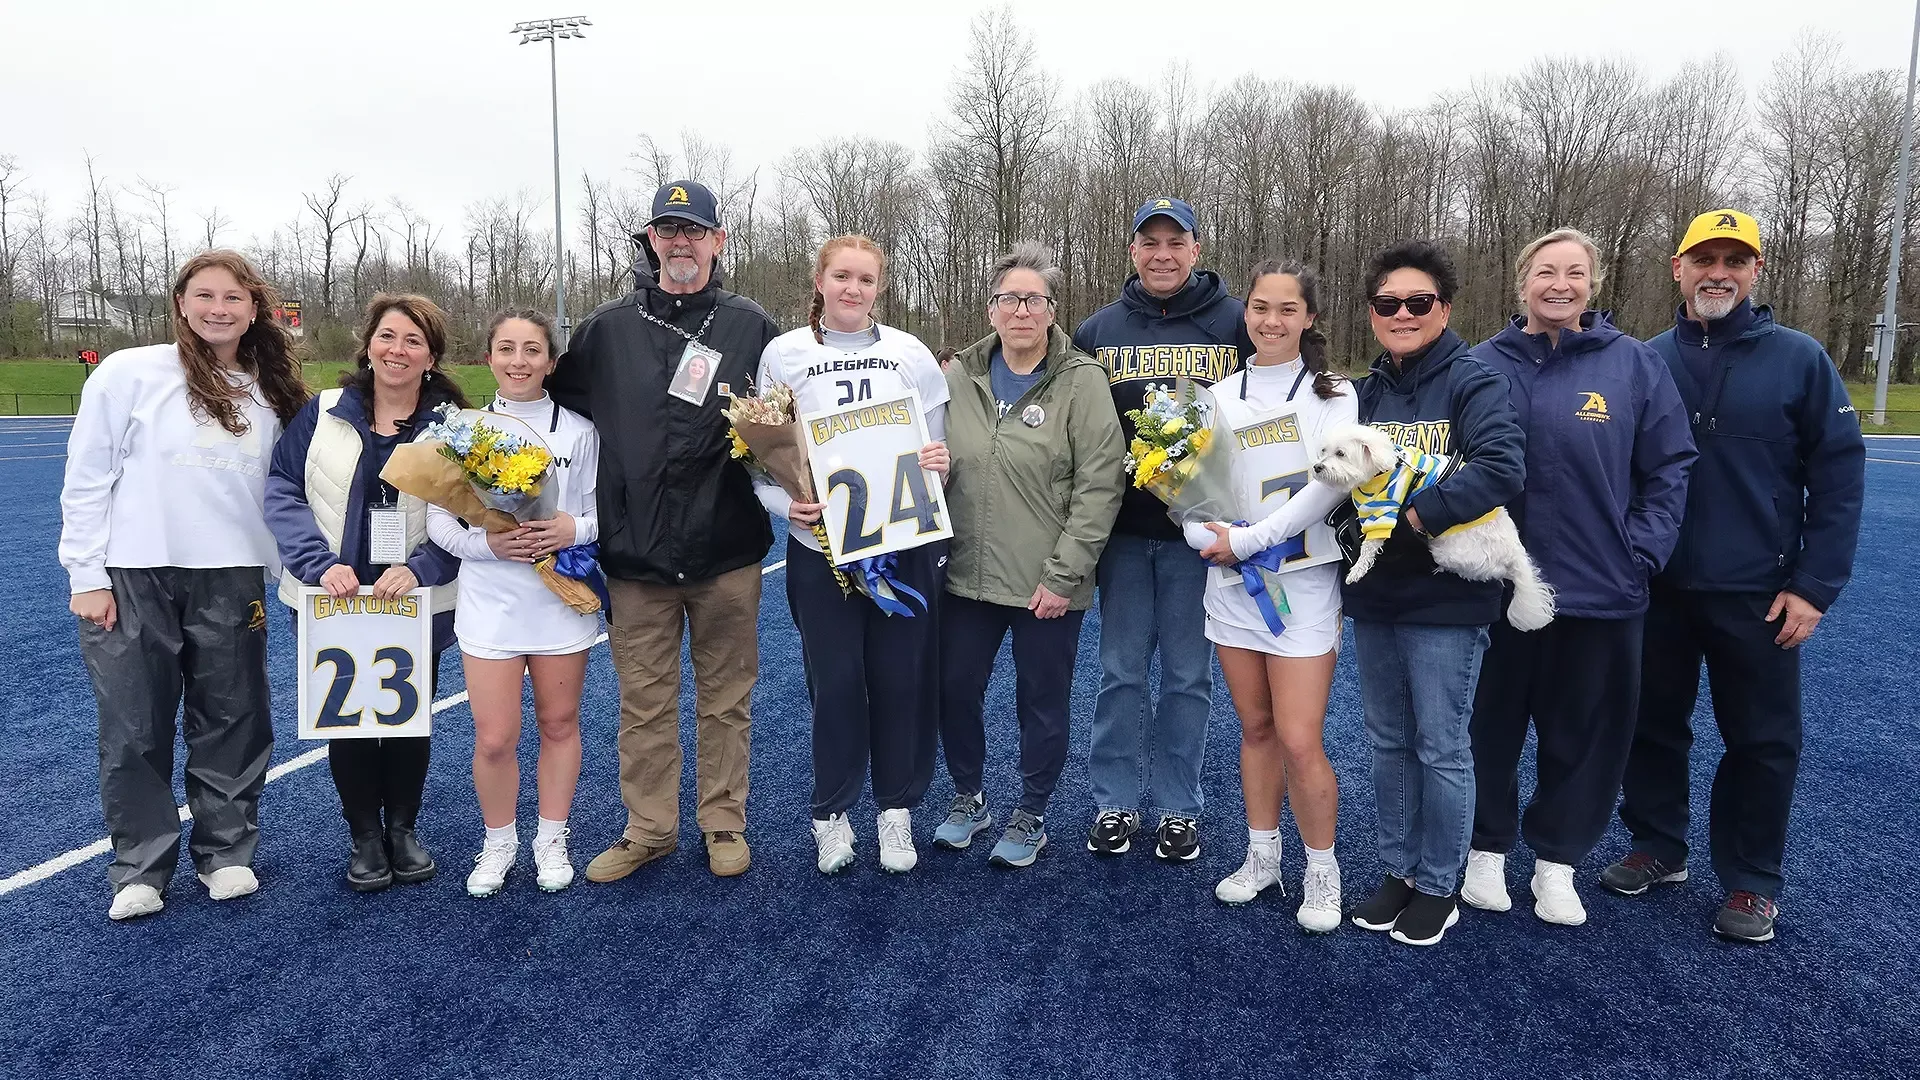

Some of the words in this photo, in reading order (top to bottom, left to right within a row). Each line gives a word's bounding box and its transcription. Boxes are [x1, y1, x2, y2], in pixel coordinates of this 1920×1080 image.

[81, 351, 97, 364] 90
[806, 358, 899, 378] ALLEGHENY
[811, 399, 911, 446] GATORS
[827, 450, 944, 556] 24
[313, 595, 418, 620] GATORS
[312, 645, 421, 730] 23
